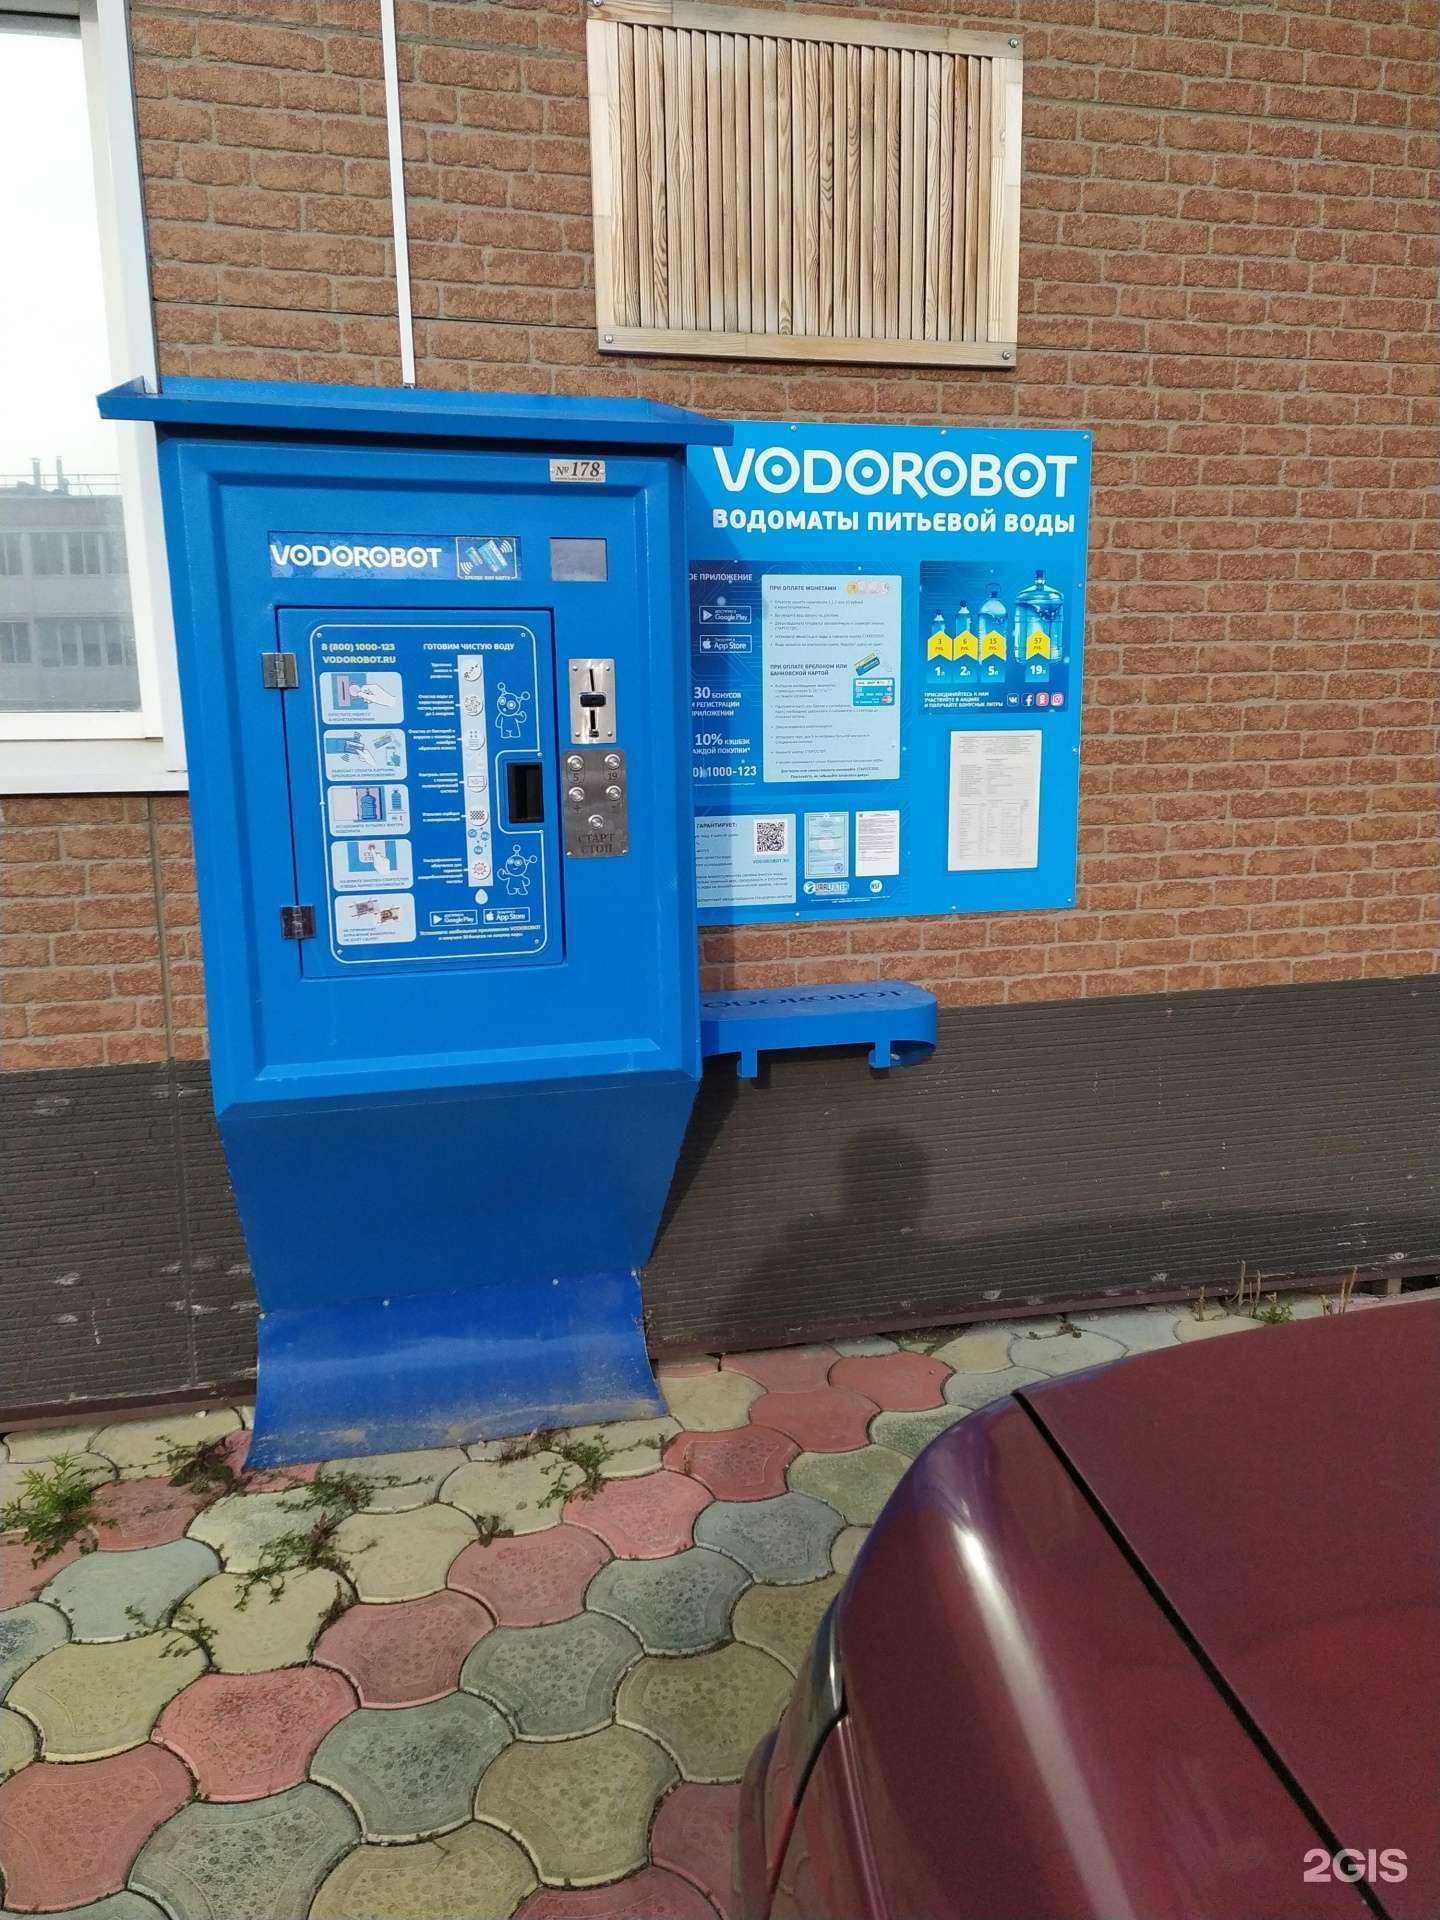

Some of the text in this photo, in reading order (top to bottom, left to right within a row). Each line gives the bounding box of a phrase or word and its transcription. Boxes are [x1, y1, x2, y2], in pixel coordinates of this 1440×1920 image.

[571, 461, 600, 477] 178
[712, 446, 1078, 499] VODOROBOT
[712, 508, 1075, 536] ВОДОМАТЫ ПИТЬЕВОЙ ВОДЫ
[269, 544, 443, 569] VODOROBOT
[700, 573, 753, 581] ПРИЛОЖЕНИЕ
[321, 642, 396, 652] 8 (800) 1000-123
[423, 643, 515, 651] ГОТОВИМ ЧИСТУЮ ВОДУ
[714, 641, 747, 650] App Store
[322, 656, 397, 664] VODOROBOT.RU
[693, 686, 711, 699] 30
[695, 733, 724, 746] 10%
[608, 772, 618, 781] 19
[706, 765, 757, 777] 1000-123
[573, 773, 580, 782] 5
[577, 832, 616, 844] СТАРТ
[582, 843, 613, 854] СТОП
